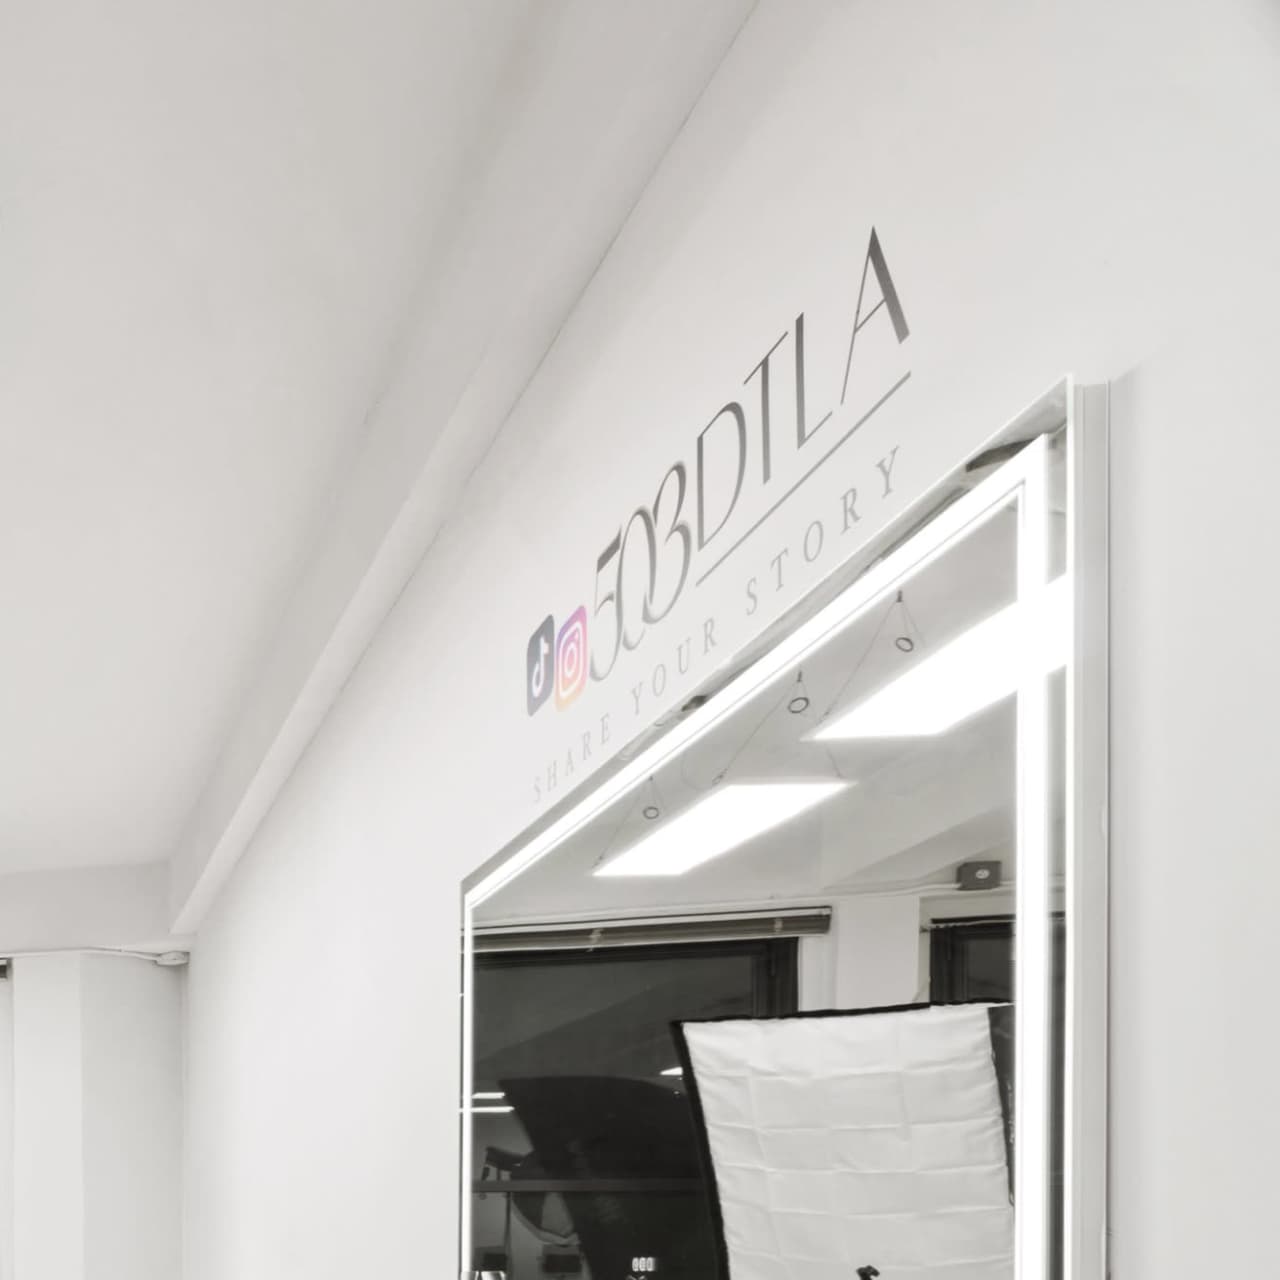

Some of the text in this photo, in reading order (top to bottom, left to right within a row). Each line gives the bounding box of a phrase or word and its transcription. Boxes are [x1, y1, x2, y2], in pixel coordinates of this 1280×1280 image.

[532, 446, 901, 803] SHARE YOUR STORY
[589, 226, 910, 682] 503DTLA
